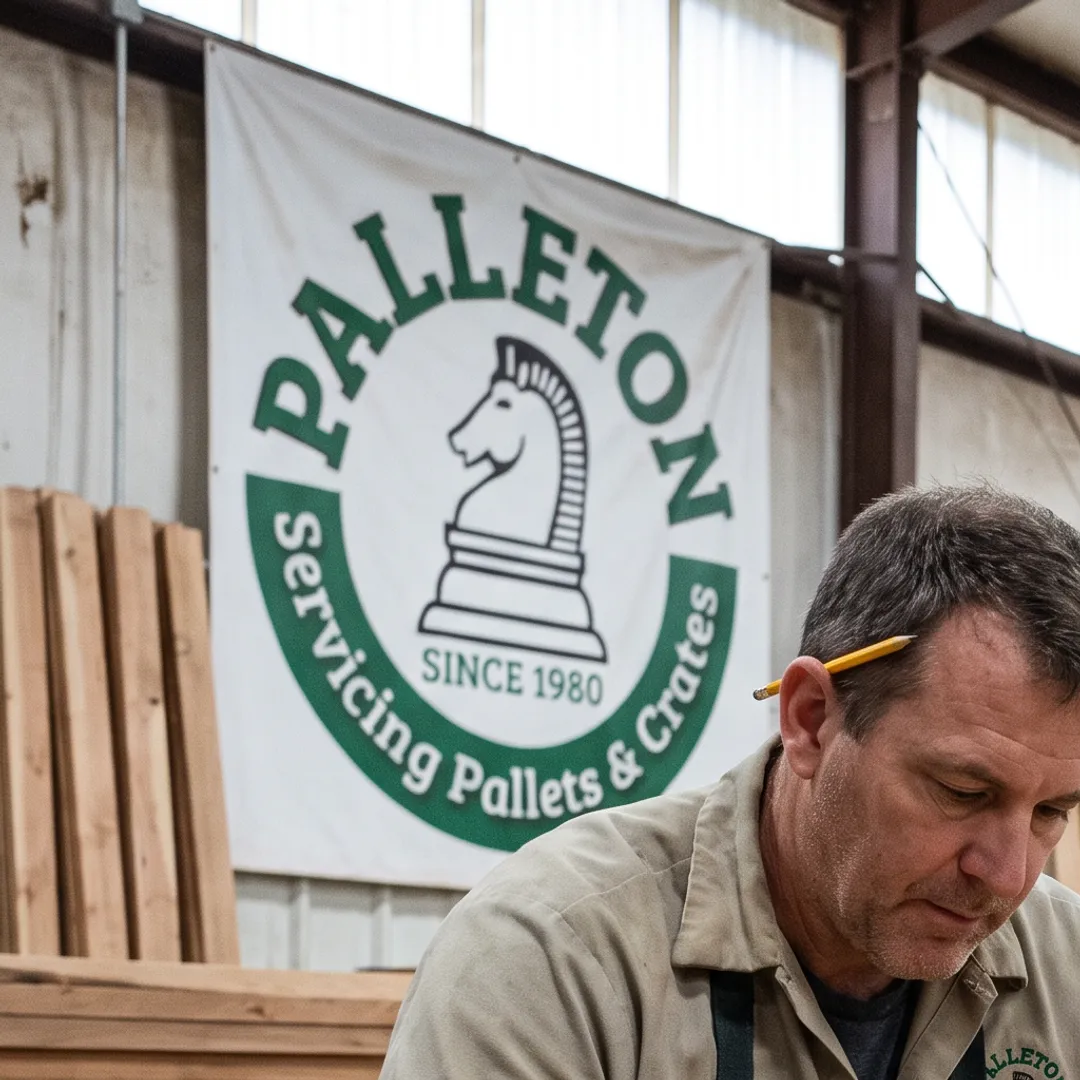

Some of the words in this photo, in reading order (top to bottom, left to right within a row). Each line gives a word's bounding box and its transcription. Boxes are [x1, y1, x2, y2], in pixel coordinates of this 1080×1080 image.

[253, 195, 733, 526] PALLETON
[273, 510, 443, 795] Servicing
[447, 752, 604, 820] Pallets
[606, 739, 645, 791] &
[635, 583, 720, 755] Crates
[422, 647, 524, 695] SINCE
[533, 665, 603, 706] 1980
